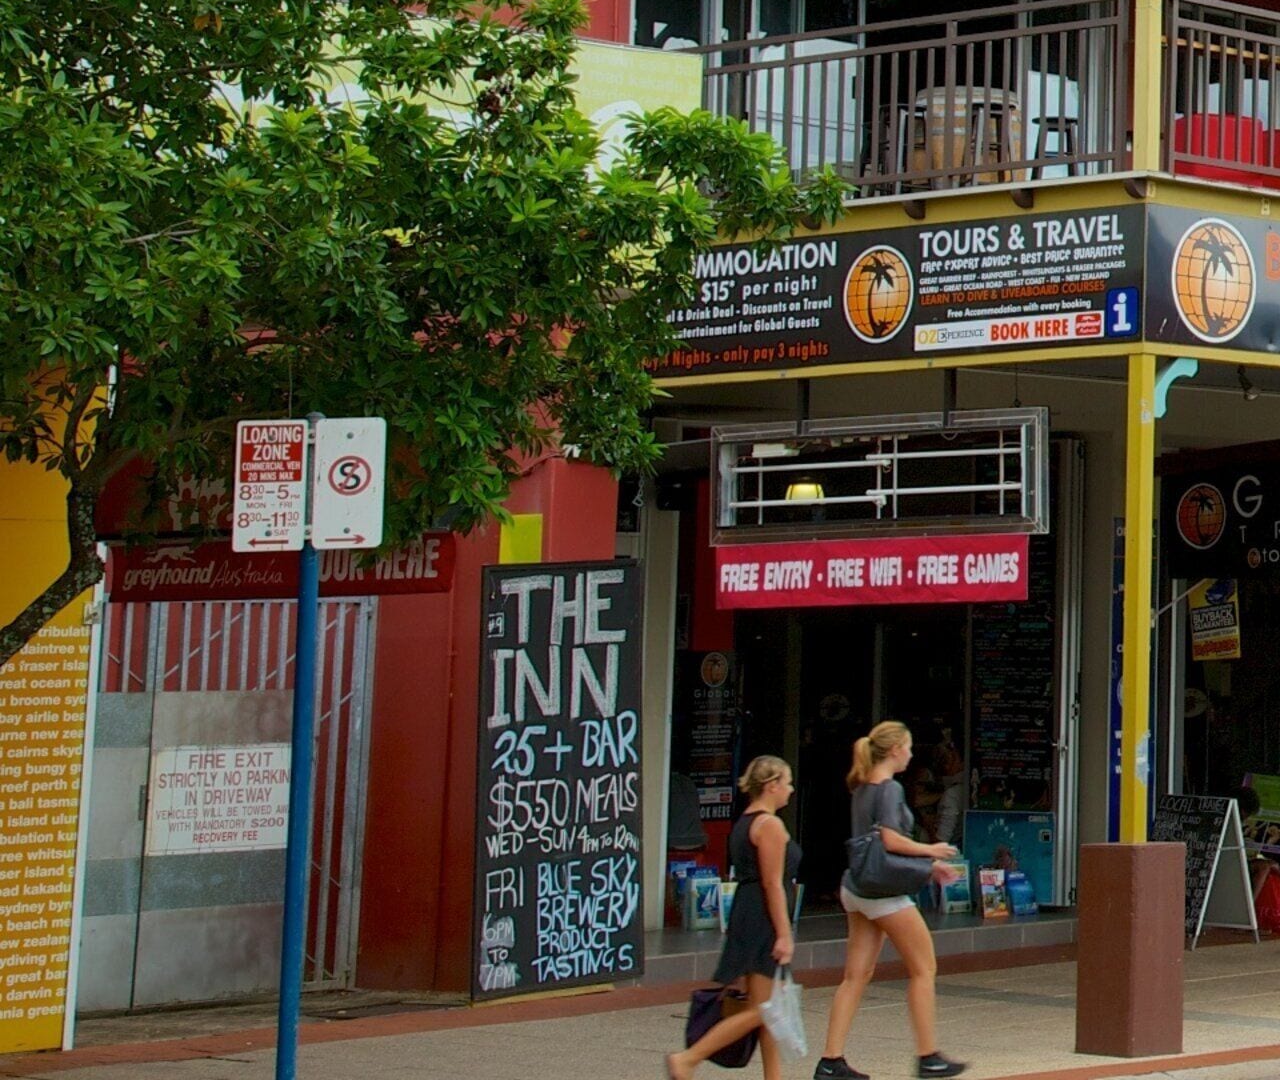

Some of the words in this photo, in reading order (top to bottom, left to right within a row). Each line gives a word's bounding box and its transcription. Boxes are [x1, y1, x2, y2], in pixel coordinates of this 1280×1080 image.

[919, 225, 1000, 258] TOURS
[1008, 223, 1024, 250] &
[1033, 214, 1124, 247] TRAVEL
[742, 281, 769, 299] per
[774, 274, 817, 297] night
[952, 292, 965, 302] TO
[967, 291, 988, 301] DIVE
[1062, 281, 1105, 293] COURSES
[803, 295, 832, 310] Travel
[947, 308, 963, 318] Free
[1023, 301, 1039, 311] with
[754, 317, 785, 332] Global
[990, 321, 1029, 342] BOOK
[1035, 318, 1069, 337] HERE
[243, 426, 301, 443] LOADING
[253, 444, 291, 461] ZONE
[242, 461, 285, 471] COMMERCIAL
[287, 461, 300, 470] VEH
[248, 472, 258, 482] 20
[260, 471, 277, 481] MINS
[279, 471, 294, 481] MAX
[122, 566, 214, 591] greyhound
[720, 563, 759, 592] FREE
[763, 560, 813, 590] ENTRY
[827, 558, 864, 588] FREE
[870, 556, 902, 587] WIFI
[917, 555, 958, 585] FREE
[964, 552, 1019, 584] GAMES
[500, 569, 627, 645] THE
[19, 660, 59, 671] fraser
[30, 678, 70, 689] ocean
[487, 644, 619, 729] INN
[10, 695, 61, 706] broome
[26, 711, 60, 723] airlie
[31, 731, 58, 740] new
[579, 710, 639, 768] BAR
[7, 746, 48, 758] cairns
[189, 753, 226, 769] FIRE
[235, 752, 273, 767] EXIT
[31, 779, 67, 793] perth
[158, 771, 218, 789] STRICTLY
[223, 771, 242, 786] NO
[9, 797, 33, 810] bali
[184, 790, 198, 806] IN
[203, 788, 272, 805] DRIVEWAY
[575, 772, 638, 824] MEALS
[156, 808, 198, 820] VEHICLES
[227, 807, 238, 816] BE
[242, 805, 272, 815] TOWED
[169, 822, 191, 832] WITH
[194, 819, 246, 831] MANDATORY
[193, 831, 238, 844] RECOVERY
[243, 831, 258, 841] FEE
[23, 882, 72, 896] kakadu
[485, 866, 524, 912] FRI
[537, 861, 582, 897] BLUE
[590, 852, 637, 895] SKY
[537, 882, 640, 935] BREWERY
[7, 917, 48, 931] beach
[538, 927, 619, 957] PRODUCT
[6, 970, 42, 986] great
[6, 986, 52, 1002] darwin
